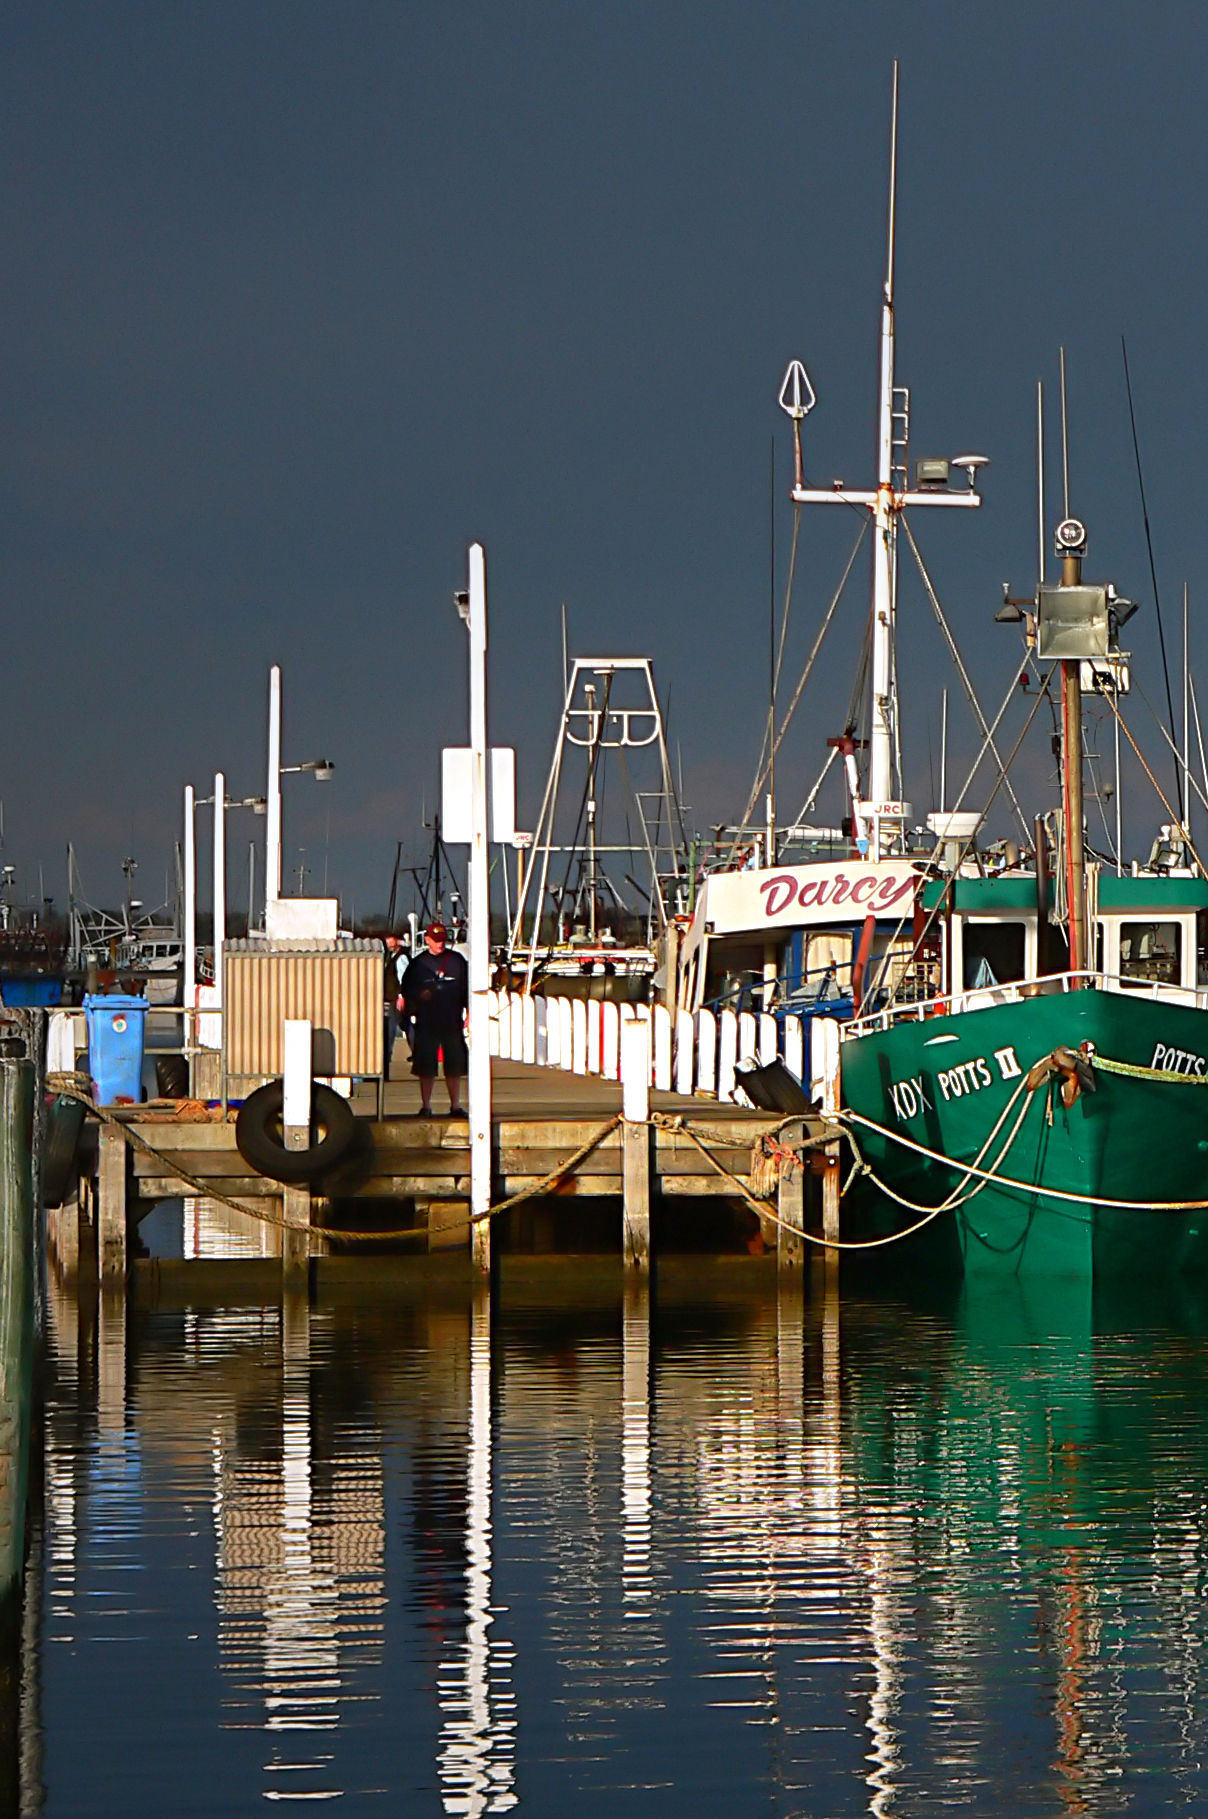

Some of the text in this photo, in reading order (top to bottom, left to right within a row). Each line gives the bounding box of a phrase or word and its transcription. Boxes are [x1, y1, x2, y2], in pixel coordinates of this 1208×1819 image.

[874, 804, 900, 815] JRC
[760, 873, 914, 917] Darcy
[888, 1046, 1023, 1122] XDX POTTS II
[1151, 1043, 1206, 1085] POTTS
